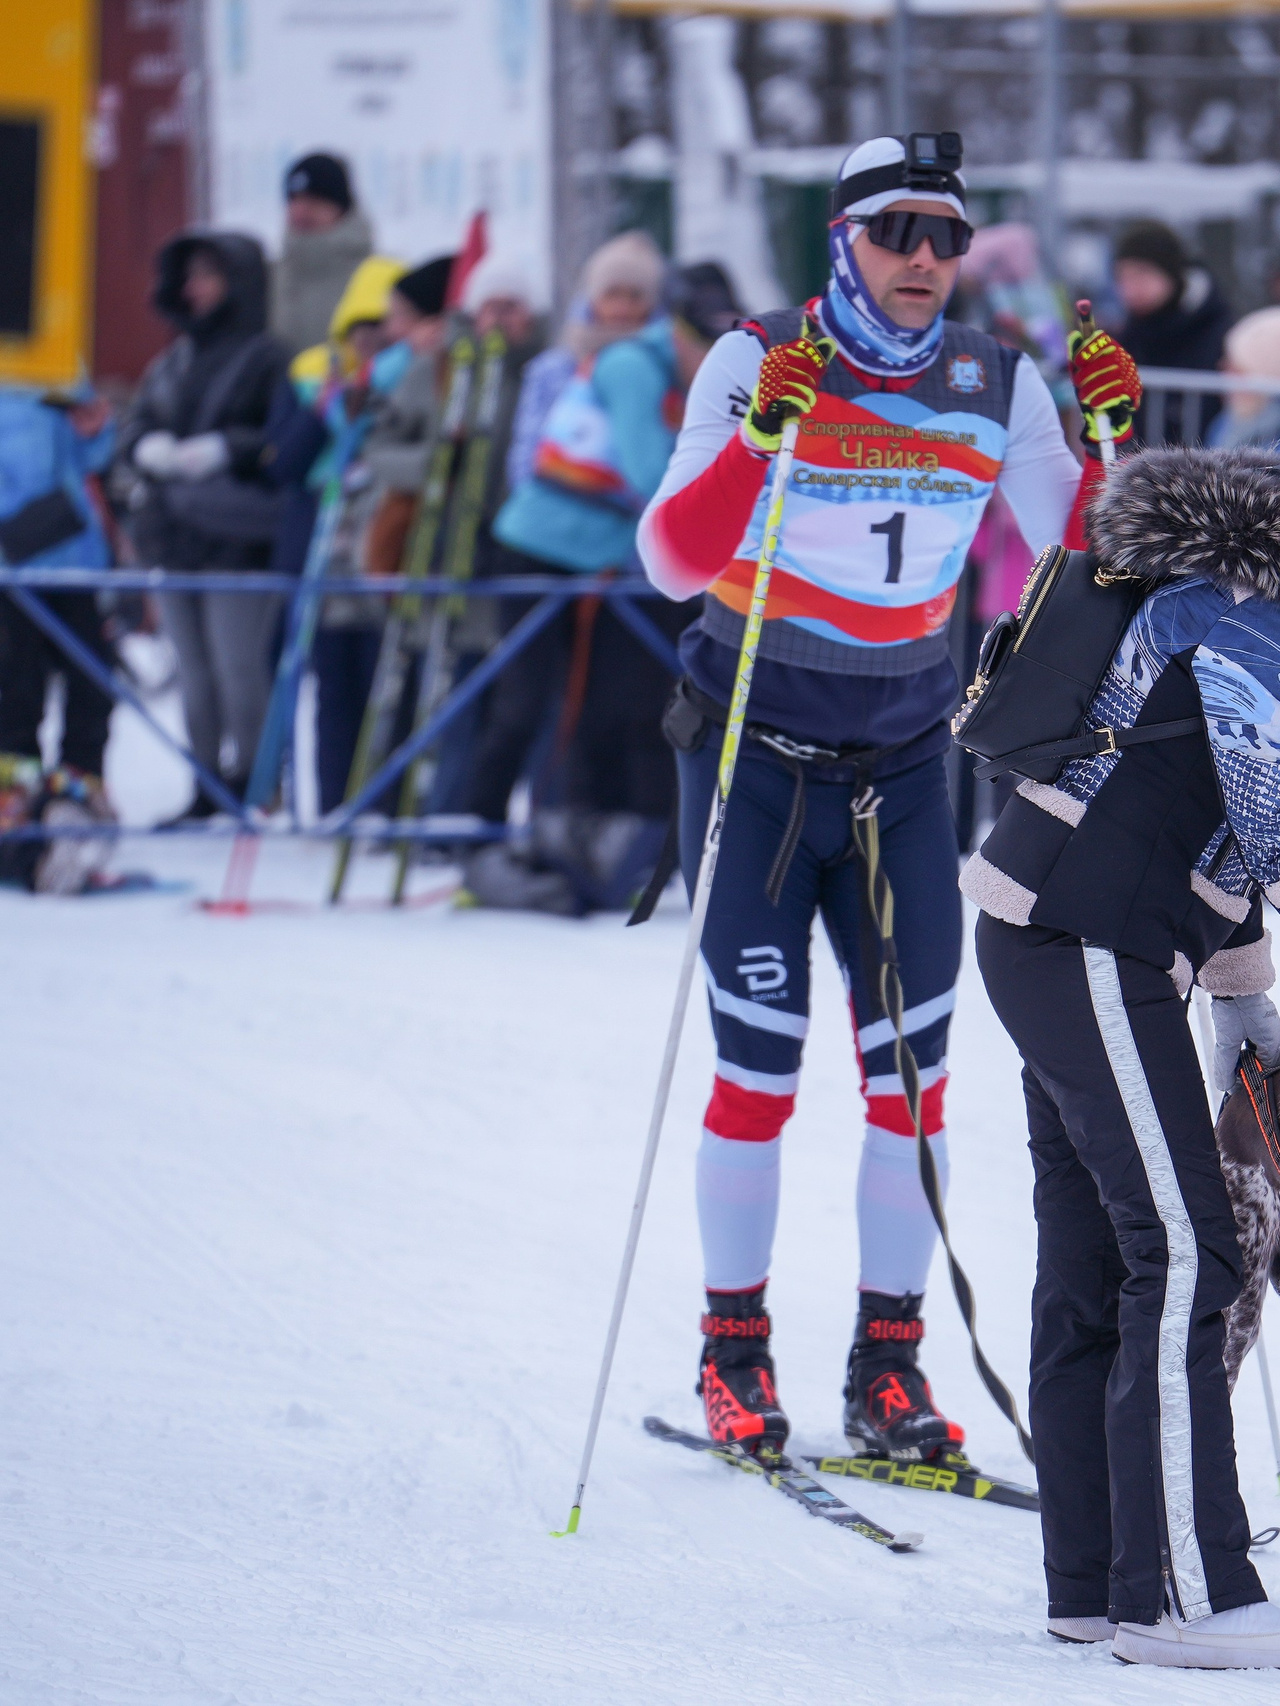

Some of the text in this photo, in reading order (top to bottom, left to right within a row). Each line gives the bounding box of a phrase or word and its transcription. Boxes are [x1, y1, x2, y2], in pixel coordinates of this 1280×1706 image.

[801, 418, 978, 446] Спортивная школа
[841, 439, 940, 473] Чайка
[793, 468, 902, 490] Самарская
[869, 511, 906, 584] 1
[819, 1456, 958, 1493] FISCHER
